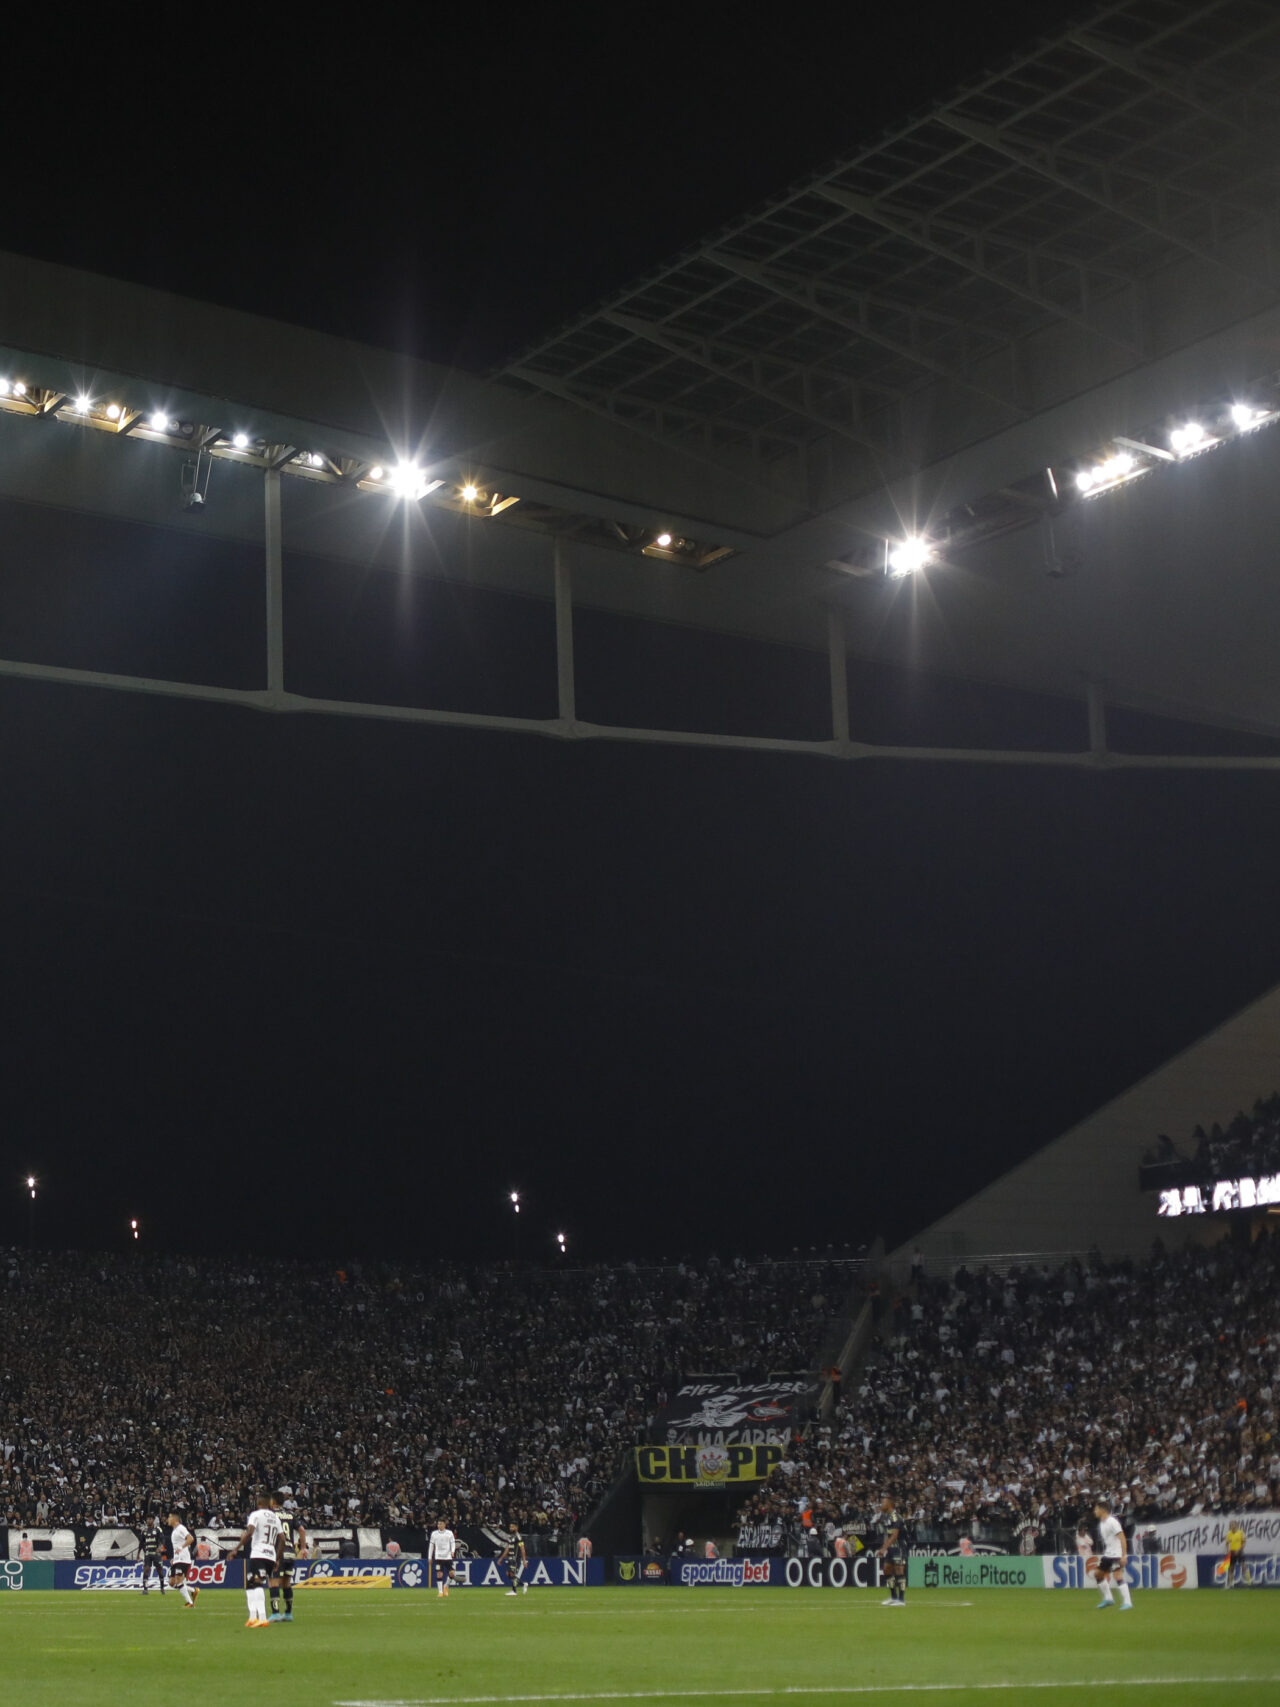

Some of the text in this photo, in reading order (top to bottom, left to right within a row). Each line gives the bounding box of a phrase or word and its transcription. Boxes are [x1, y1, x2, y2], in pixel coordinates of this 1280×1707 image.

[681, 1559, 770, 1587] sportingbet
[944, 1564, 1026, 1585] Rei do Pitaco
[1053, 1555, 1084, 1588] Sil
